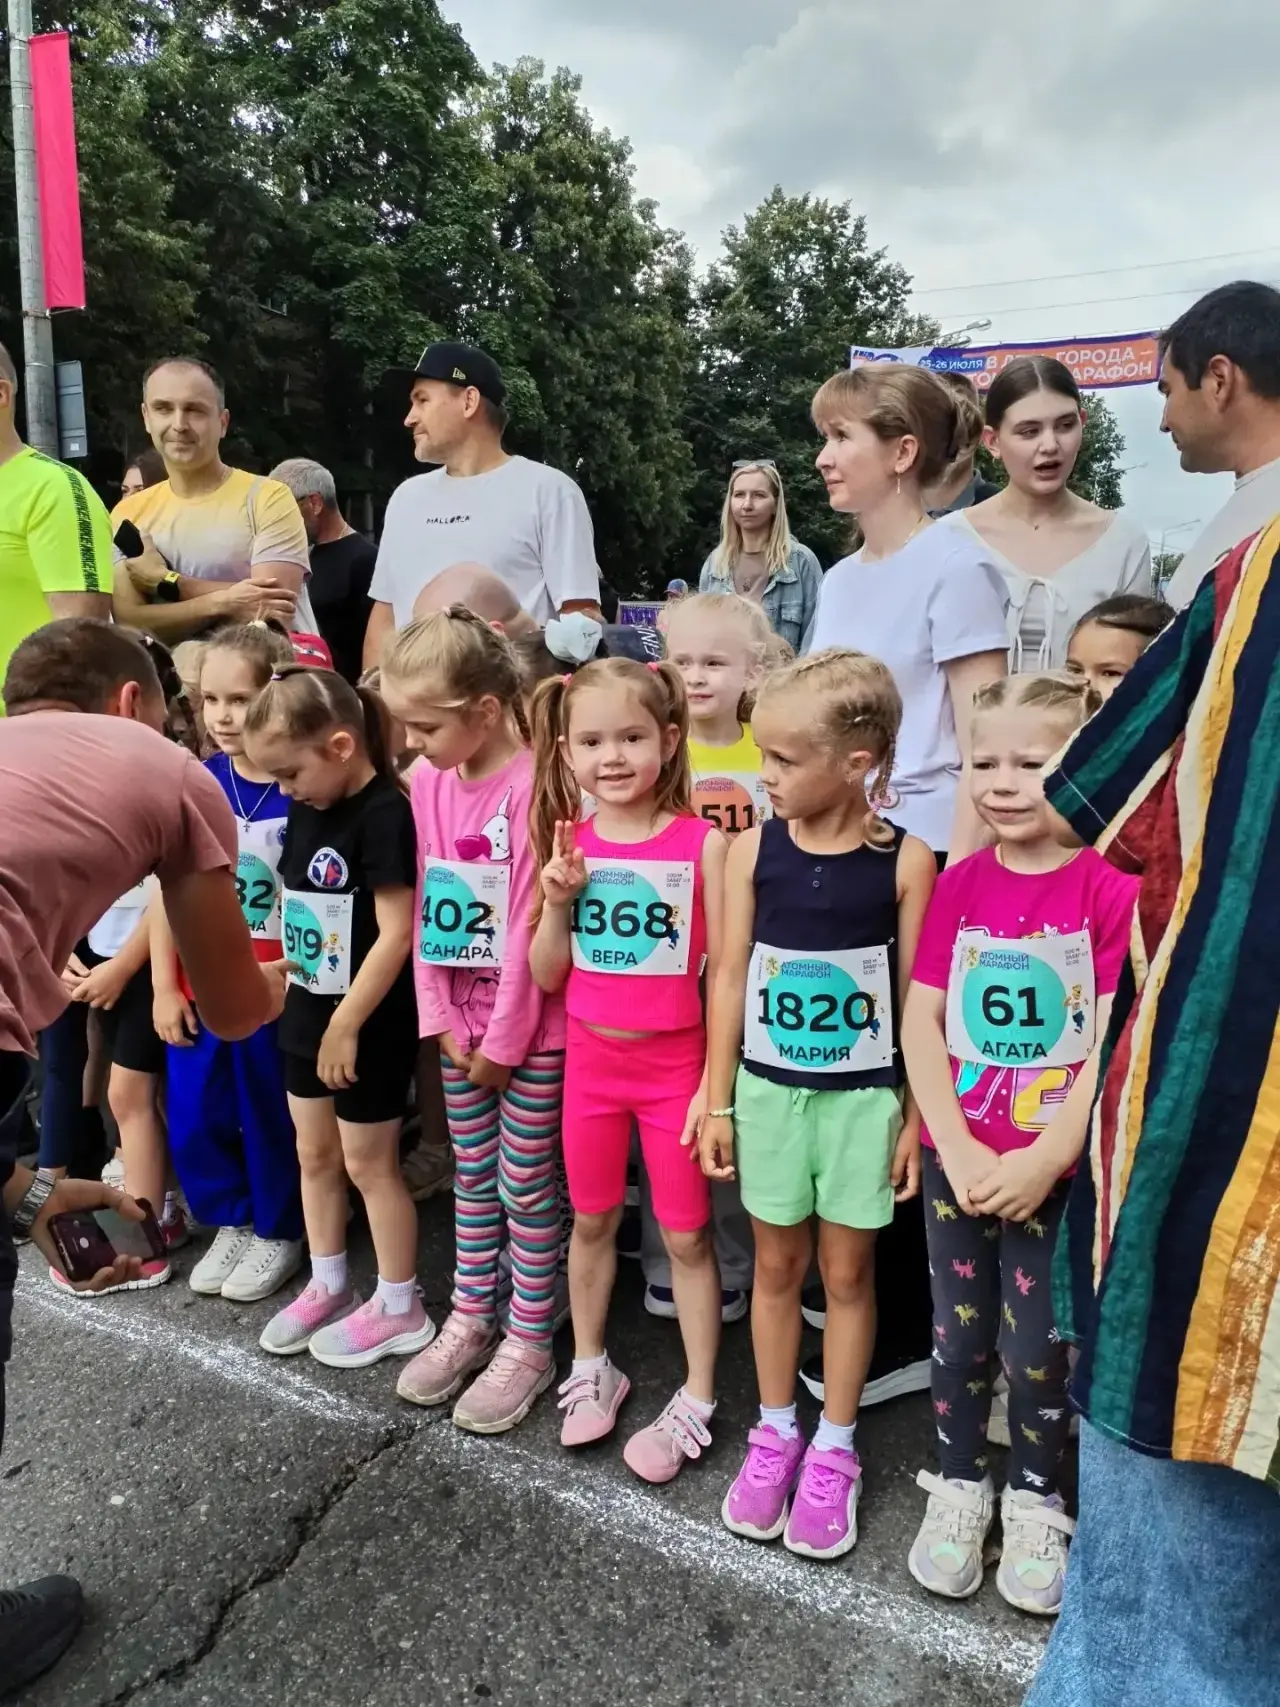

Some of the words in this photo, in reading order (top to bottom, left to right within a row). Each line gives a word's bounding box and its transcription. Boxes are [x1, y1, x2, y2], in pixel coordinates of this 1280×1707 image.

[920, 359, 947, 369] 25-26
[949, 359, 983, 370] ИЮЛЯ
[986, 355, 998, 369] В
[1055, 347, 1136, 366] ГОРОДА
[1072, 360, 1152, 381] АРАФОН
[701, 804, 753, 833] 511
[590, 870, 635, 879] АТОМНЫЙ
[590, 877, 635, 886] МАРАФОН
[571, 898, 674, 939] 1368
[592, 949, 638, 965] ВЕРА
[979, 951, 1029, 962] АТОМНЫЙ
[980, 959, 1029, 970] МАРАФОН
[781, 961, 831, 971] АТОМНЫЙ
[781, 969, 831, 979] МАРАФОН
[758, 988, 875, 1032] 1820
[982, 985, 1044, 1027] 61
[779, 1043, 851, 1062] МАРИЯ
[981, 1040, 1047, 1059] АГАТА
